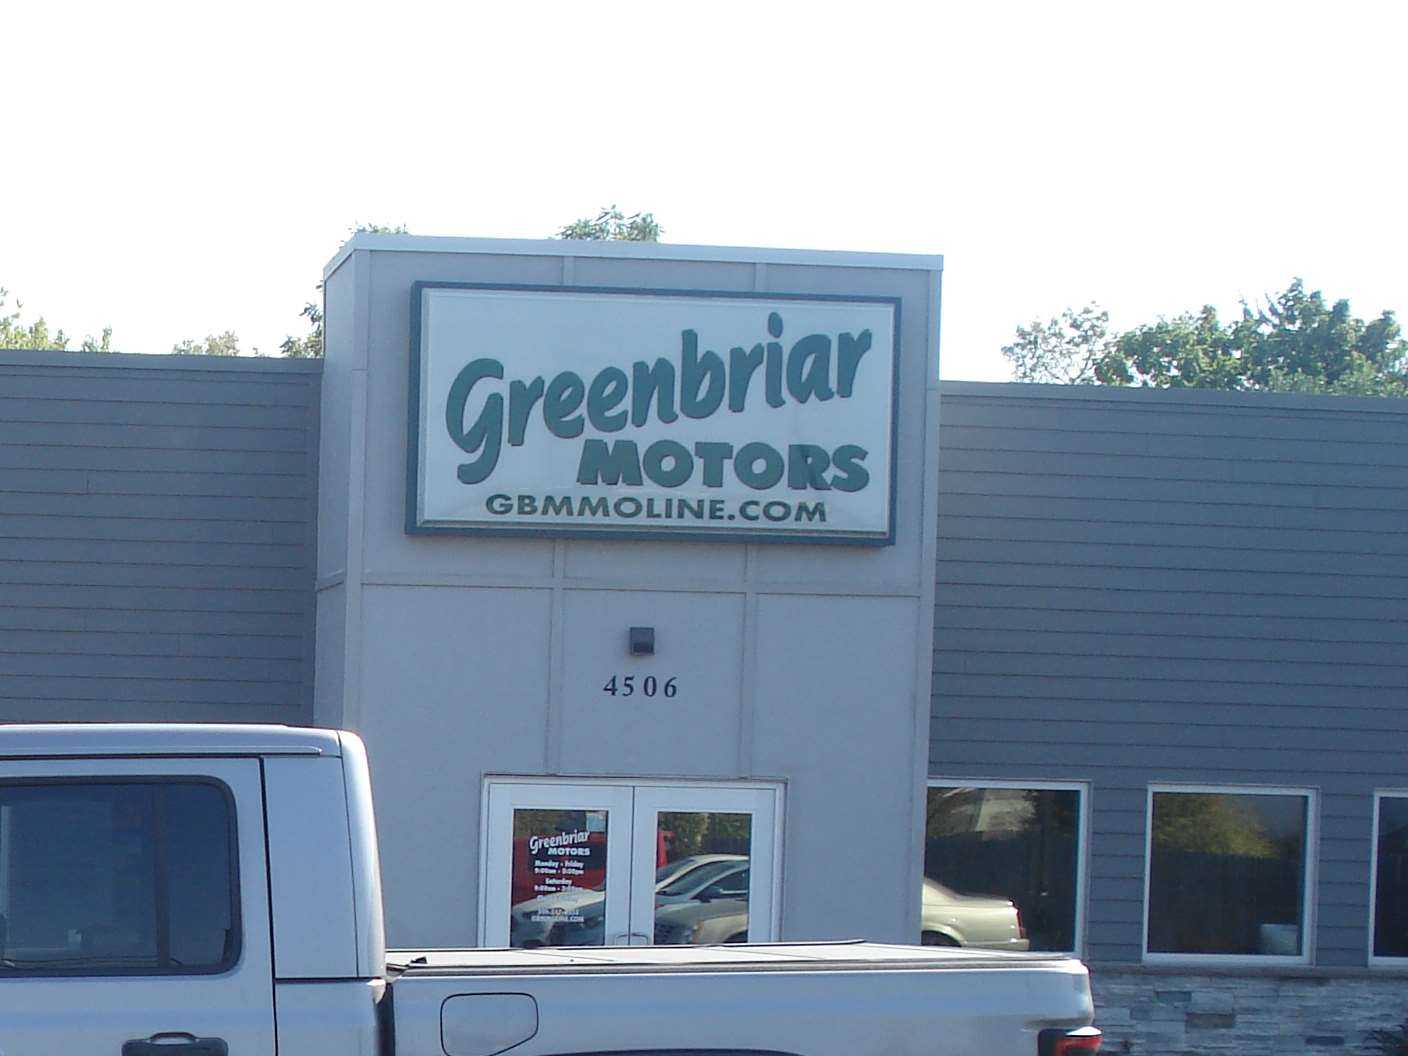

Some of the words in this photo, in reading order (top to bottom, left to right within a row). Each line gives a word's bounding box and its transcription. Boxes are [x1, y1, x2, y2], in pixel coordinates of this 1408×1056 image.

[445, 312, 873, 485] Greenbriar
[576, 438, 871, 492] MOTORS
[485, 493, 828, 523] GBMMOLINE.COM
[603, 674, 678, 699] 4506
[529, 829, 591, 855] Greenbriar
[547, 847, 591, 856] MOTORS
